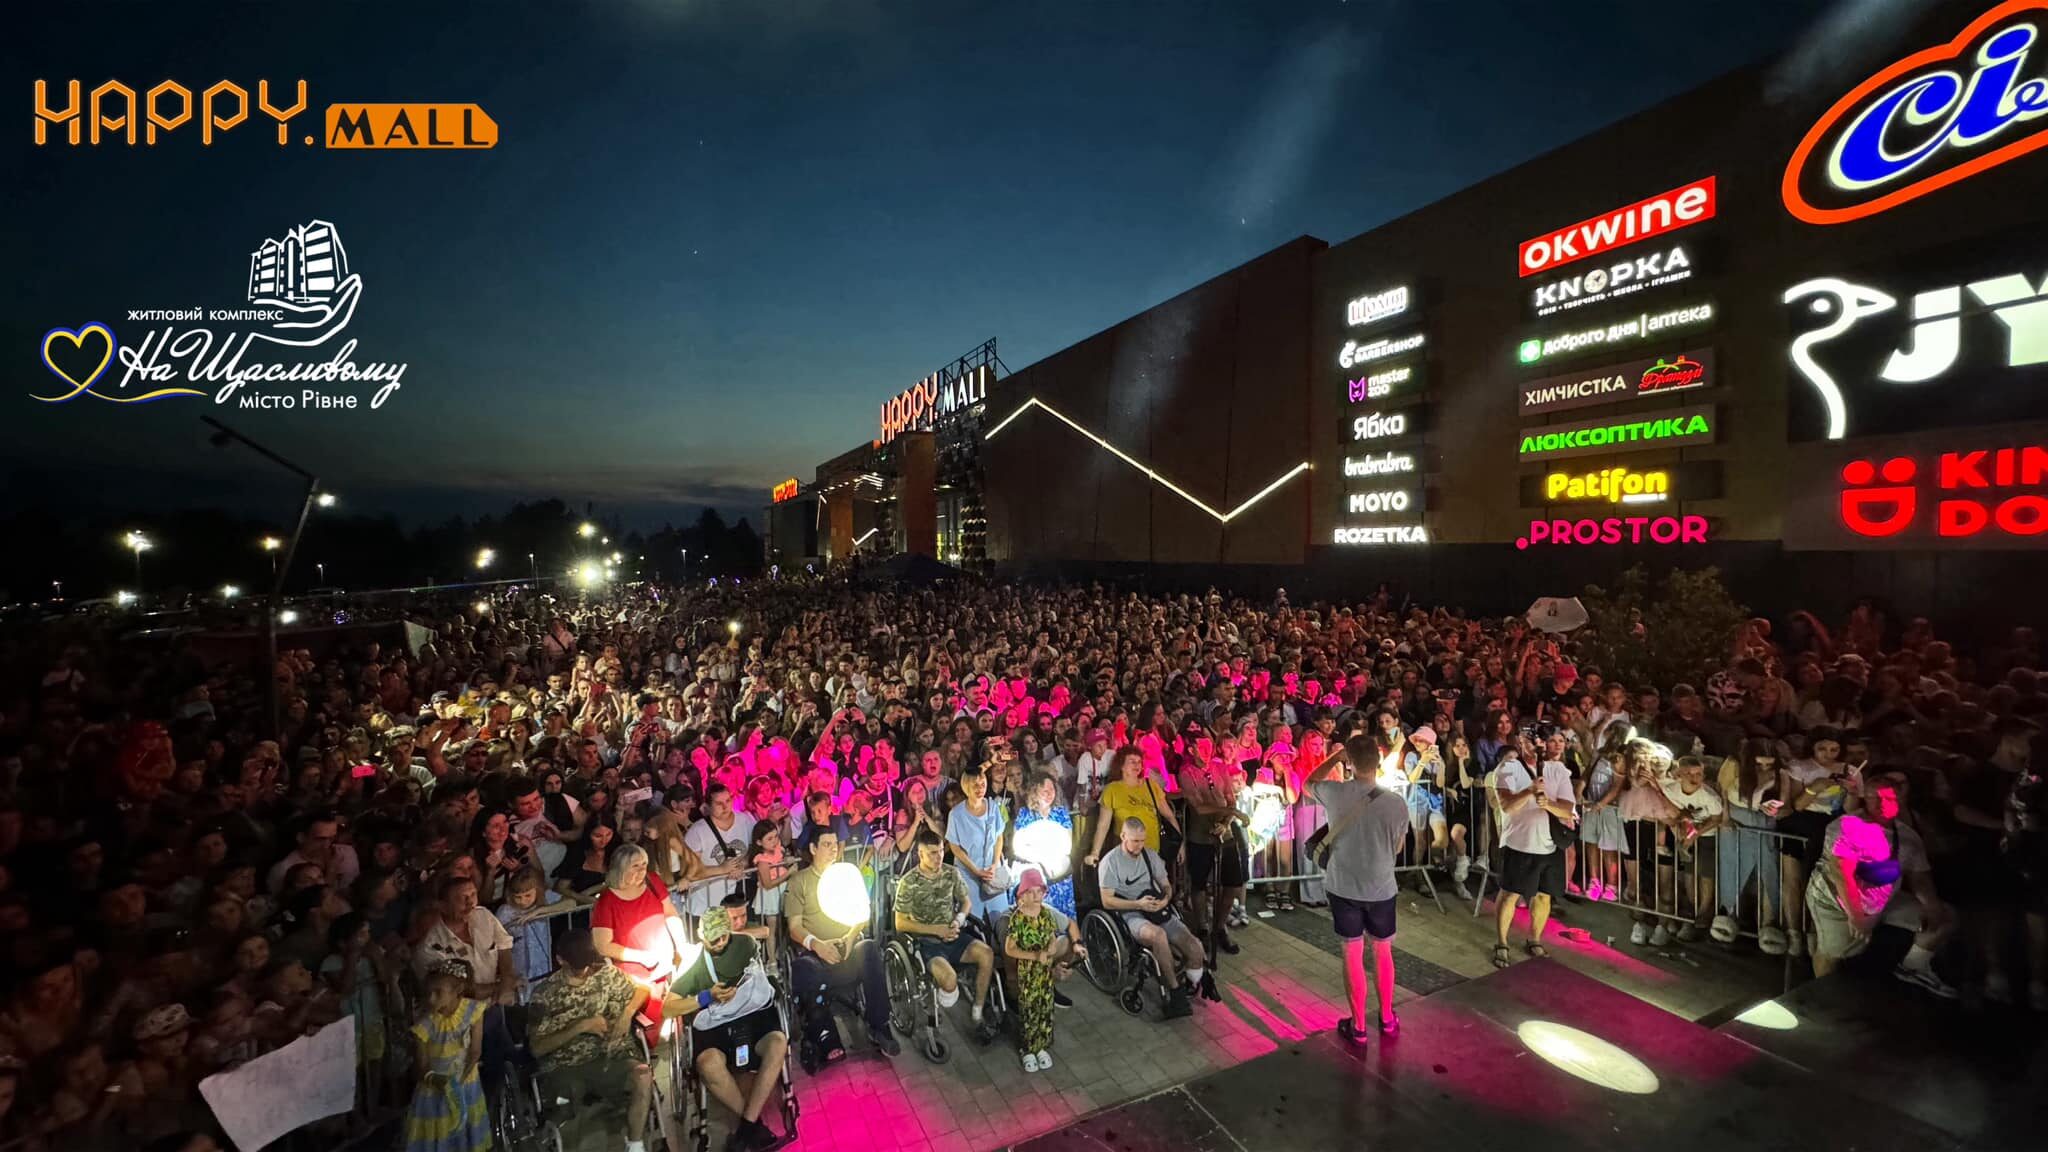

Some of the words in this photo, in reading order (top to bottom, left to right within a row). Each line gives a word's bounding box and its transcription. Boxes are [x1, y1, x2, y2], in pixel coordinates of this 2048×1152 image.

[1536, 247, 1689, 306] KNOPKA
[1542, 329, 1604, 356] доброго
[1607, 320, 1638, 342] дня
[1648, 304, 1712, 331] аптека
[1525, 375, 1627, 405] ХІМЧИСТКА
[1520, 415, 1709, 453] ЛЮКСОПТИКА
[1350, 491, 1408, 513] MOYO
[1548, 468, 1667, 502] Patifon
[1334, 526, 1428, 543] ROZETKA
